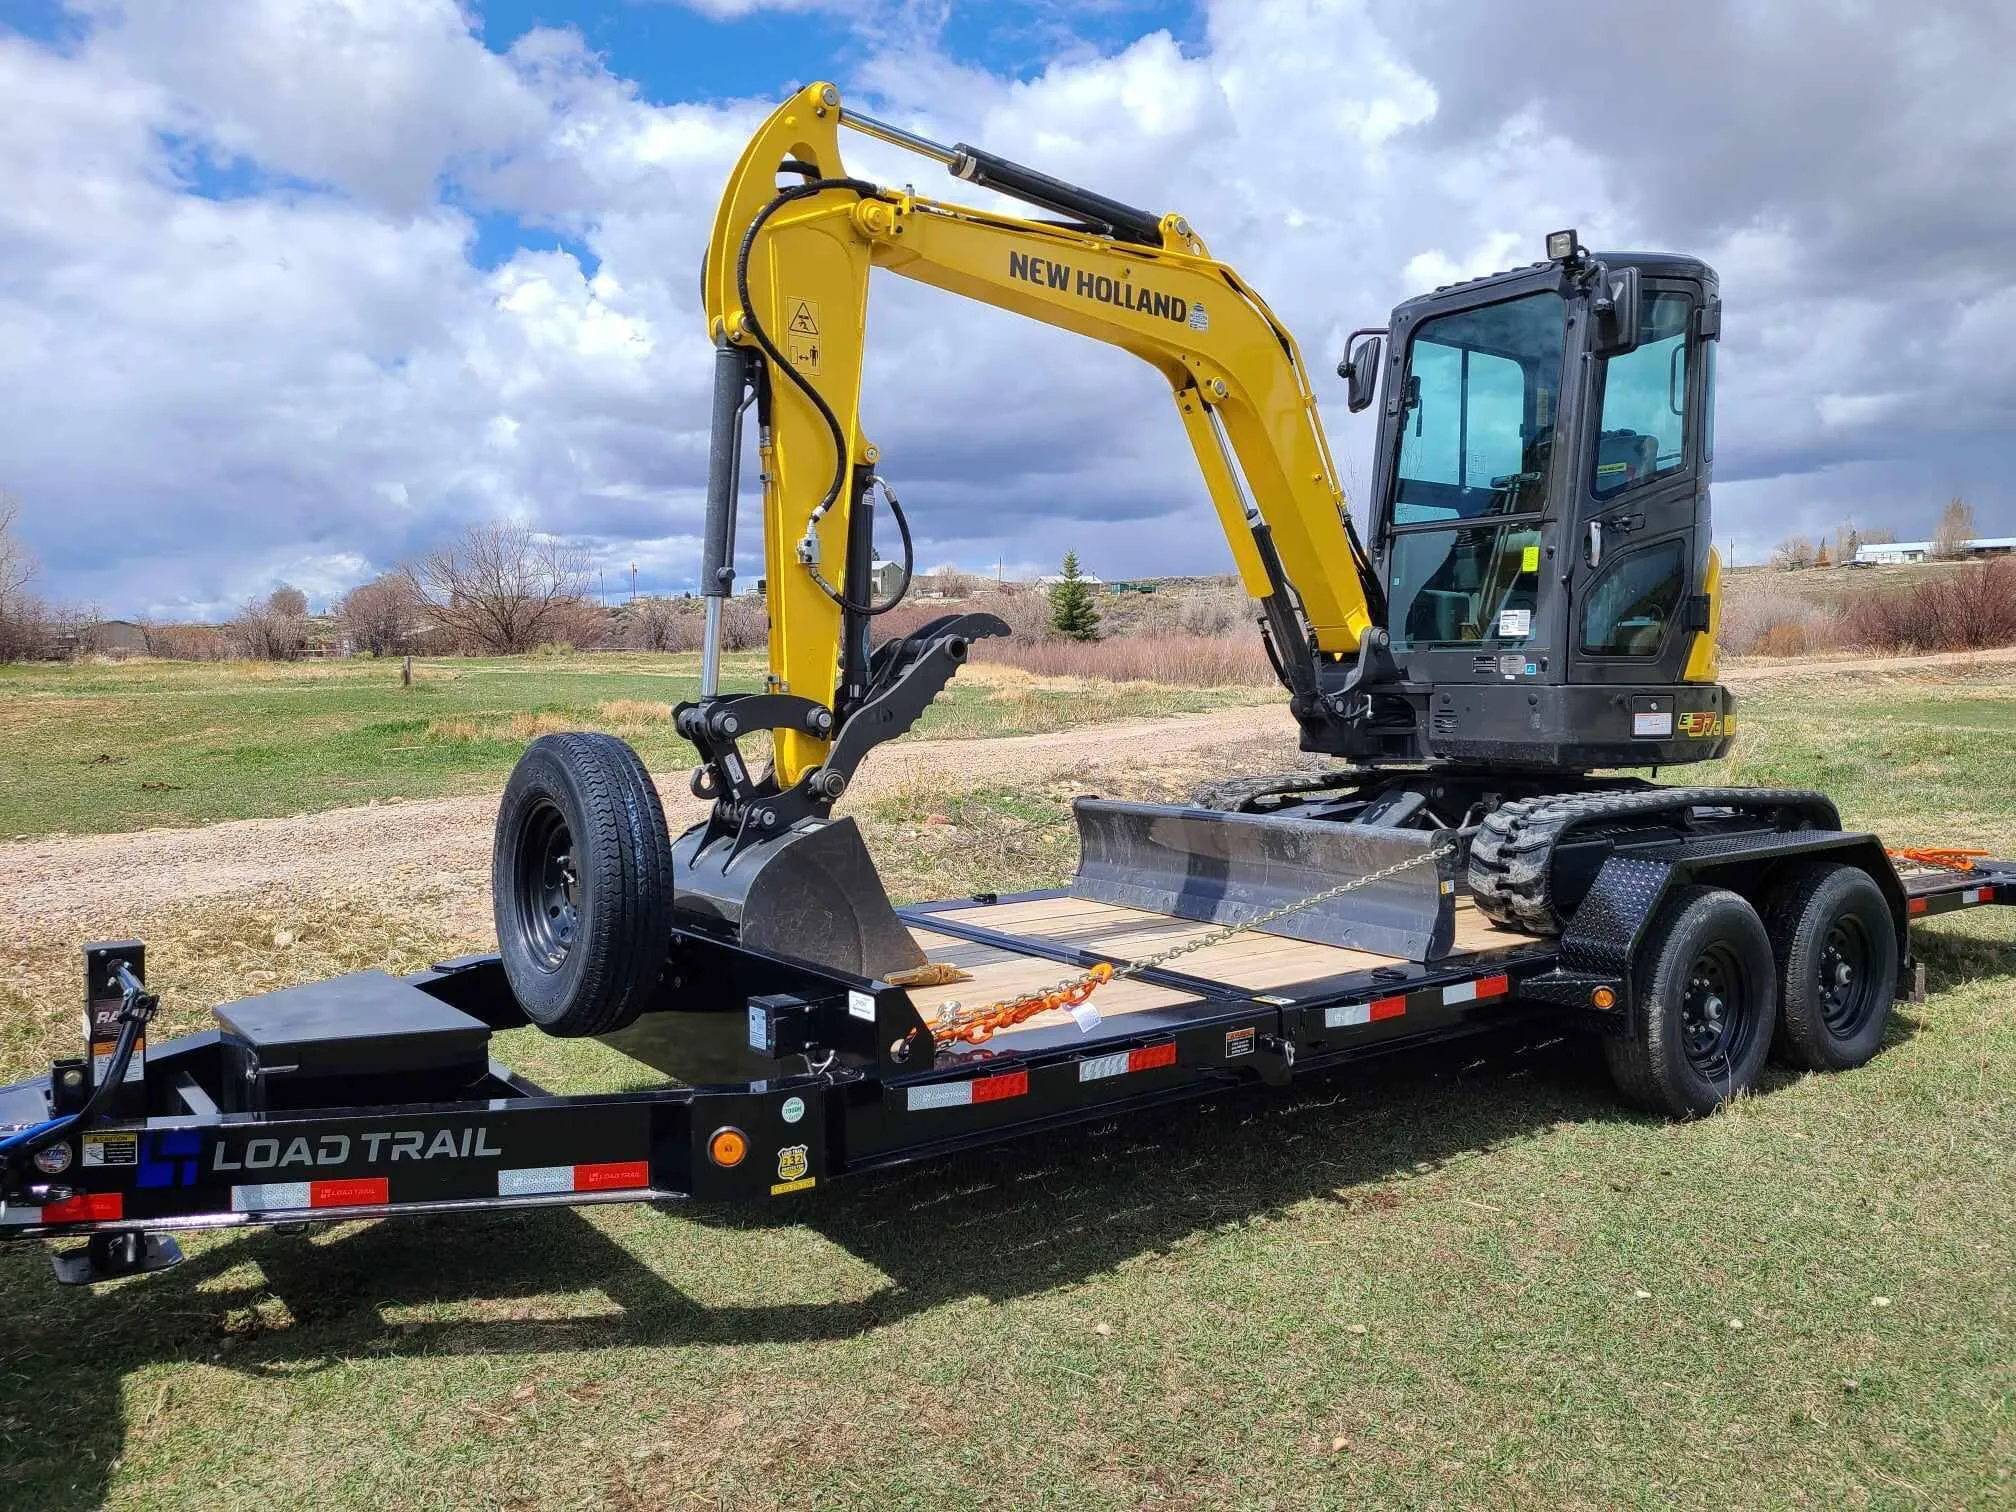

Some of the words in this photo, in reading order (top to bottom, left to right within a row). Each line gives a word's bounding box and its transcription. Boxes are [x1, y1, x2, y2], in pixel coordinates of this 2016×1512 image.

[1010, 251, 1070, 291] NEW
[1077, 271, 1186, 322] HOLLAND
[213, 1135, 350, 1171] LOAD
[361, 1128, 502, 1162] TRAIL
